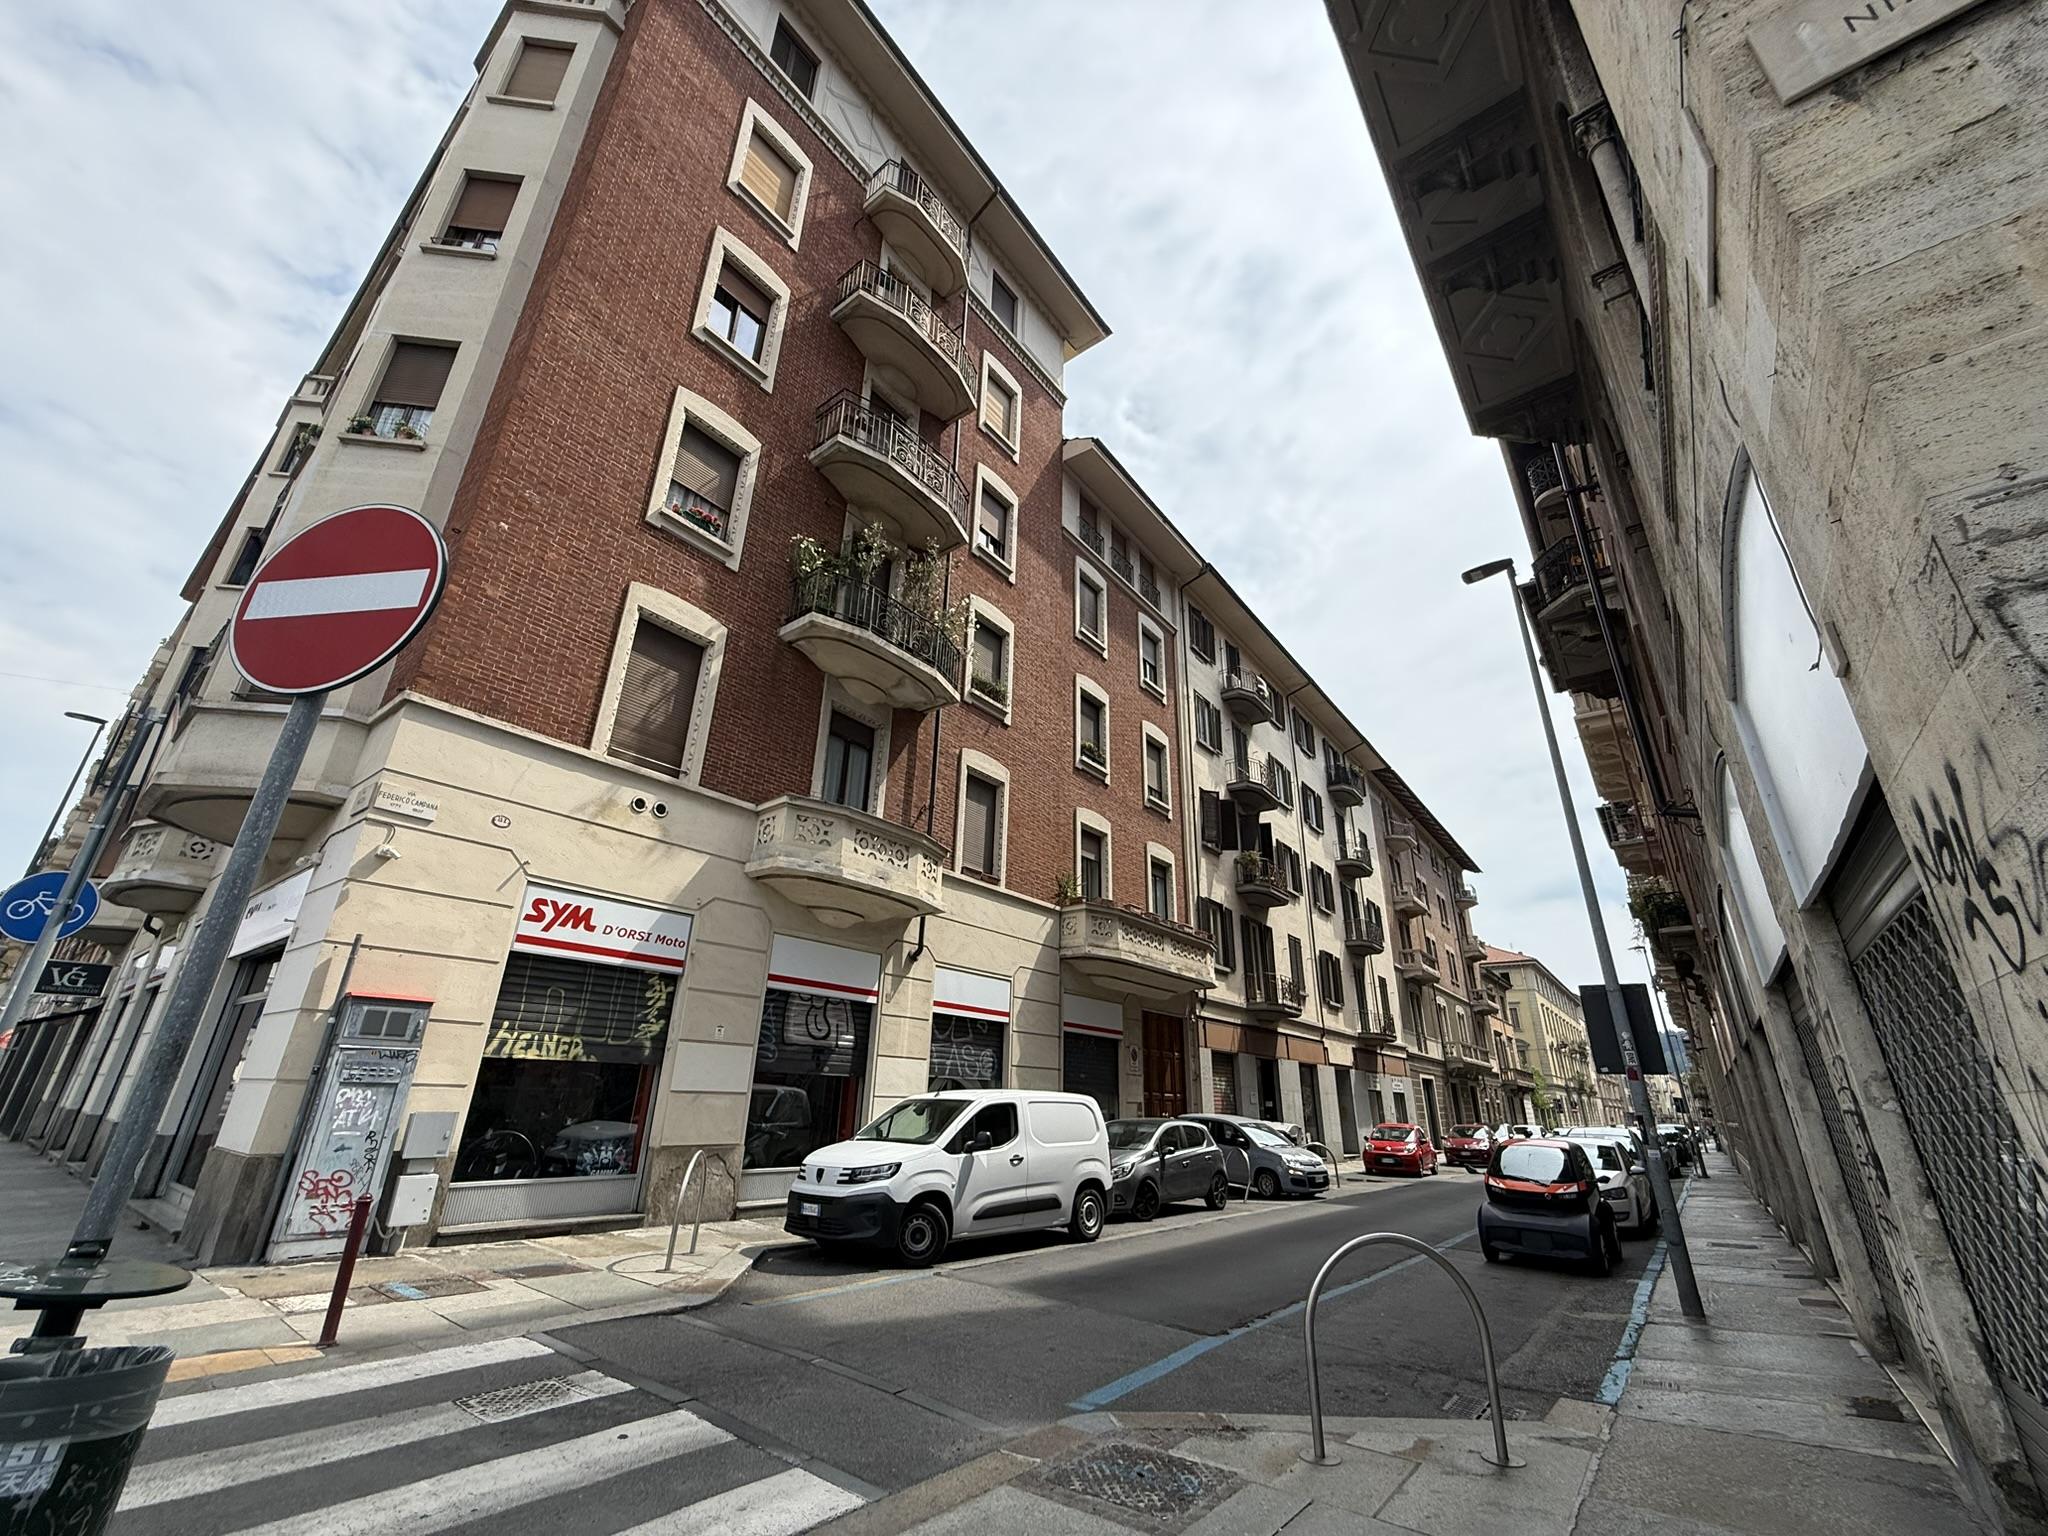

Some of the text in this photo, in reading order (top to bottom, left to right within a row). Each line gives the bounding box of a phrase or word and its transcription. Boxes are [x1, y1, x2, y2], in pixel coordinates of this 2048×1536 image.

[378, 790, 439, 811] FEDERICO CAMPANA
[522, 897, 686, 949] SYM D'ORSI Moto
